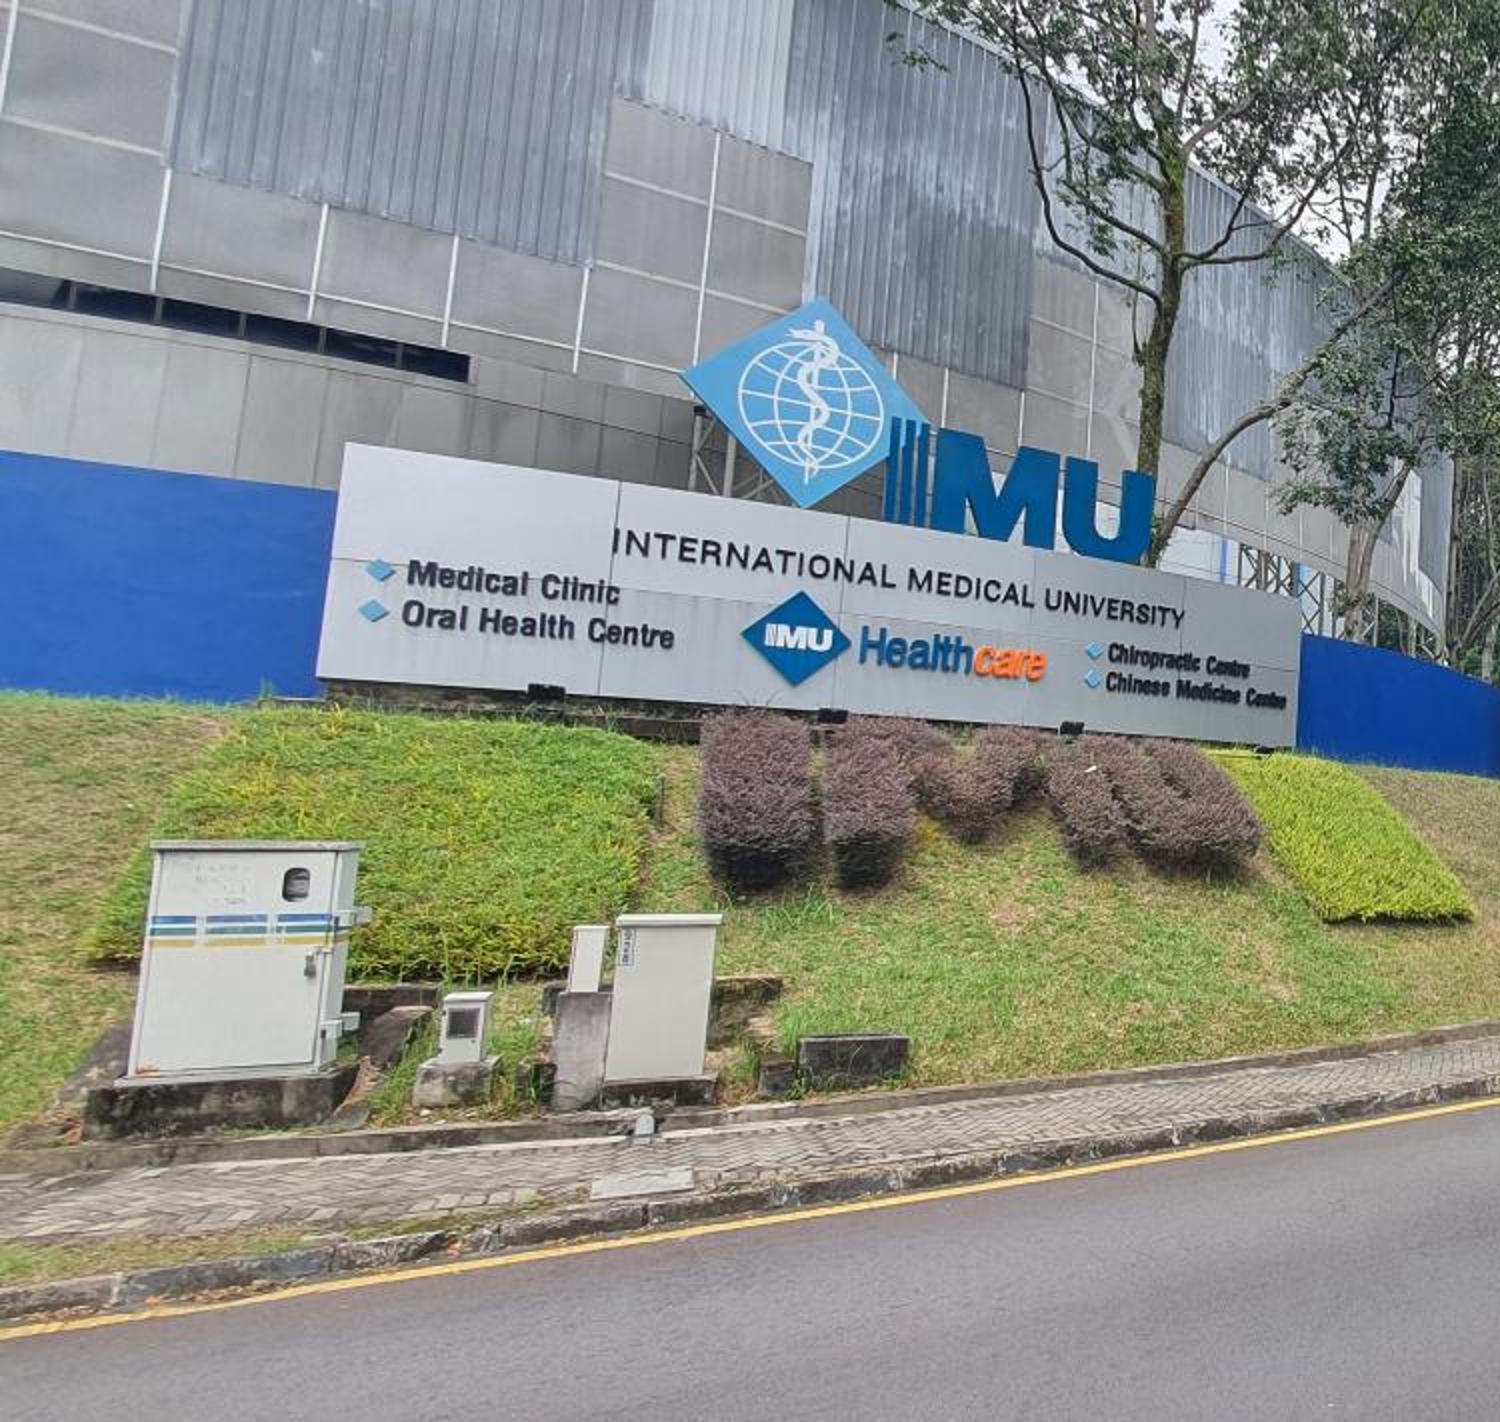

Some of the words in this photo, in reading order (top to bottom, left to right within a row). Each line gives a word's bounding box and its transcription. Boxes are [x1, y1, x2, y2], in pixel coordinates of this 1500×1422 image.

[406, 559, 529, 596] Medical
[541, 573, 621, 605] Clinic
[612, 527, 896, 589] INTERNATIONAL
[907, 567, 1035, 608] MEDICAL
[1045, 587, 1185, 630] UNIVERSITY
[401, 600, 467, 632] Oral
[479, 607, 575, 641] Health
[587, 617, 675, 649] Centre
[765, 623, 834, 652] IMU
[1107, 642, 1200, 673] Chiropractic
[1205, 655, 1251, 679] Centre
[1105, 671, 1170, 697] Chinese
[1175, 678, 1241, 705] Medicine
[1245, 687, 1287, 710] Centre
